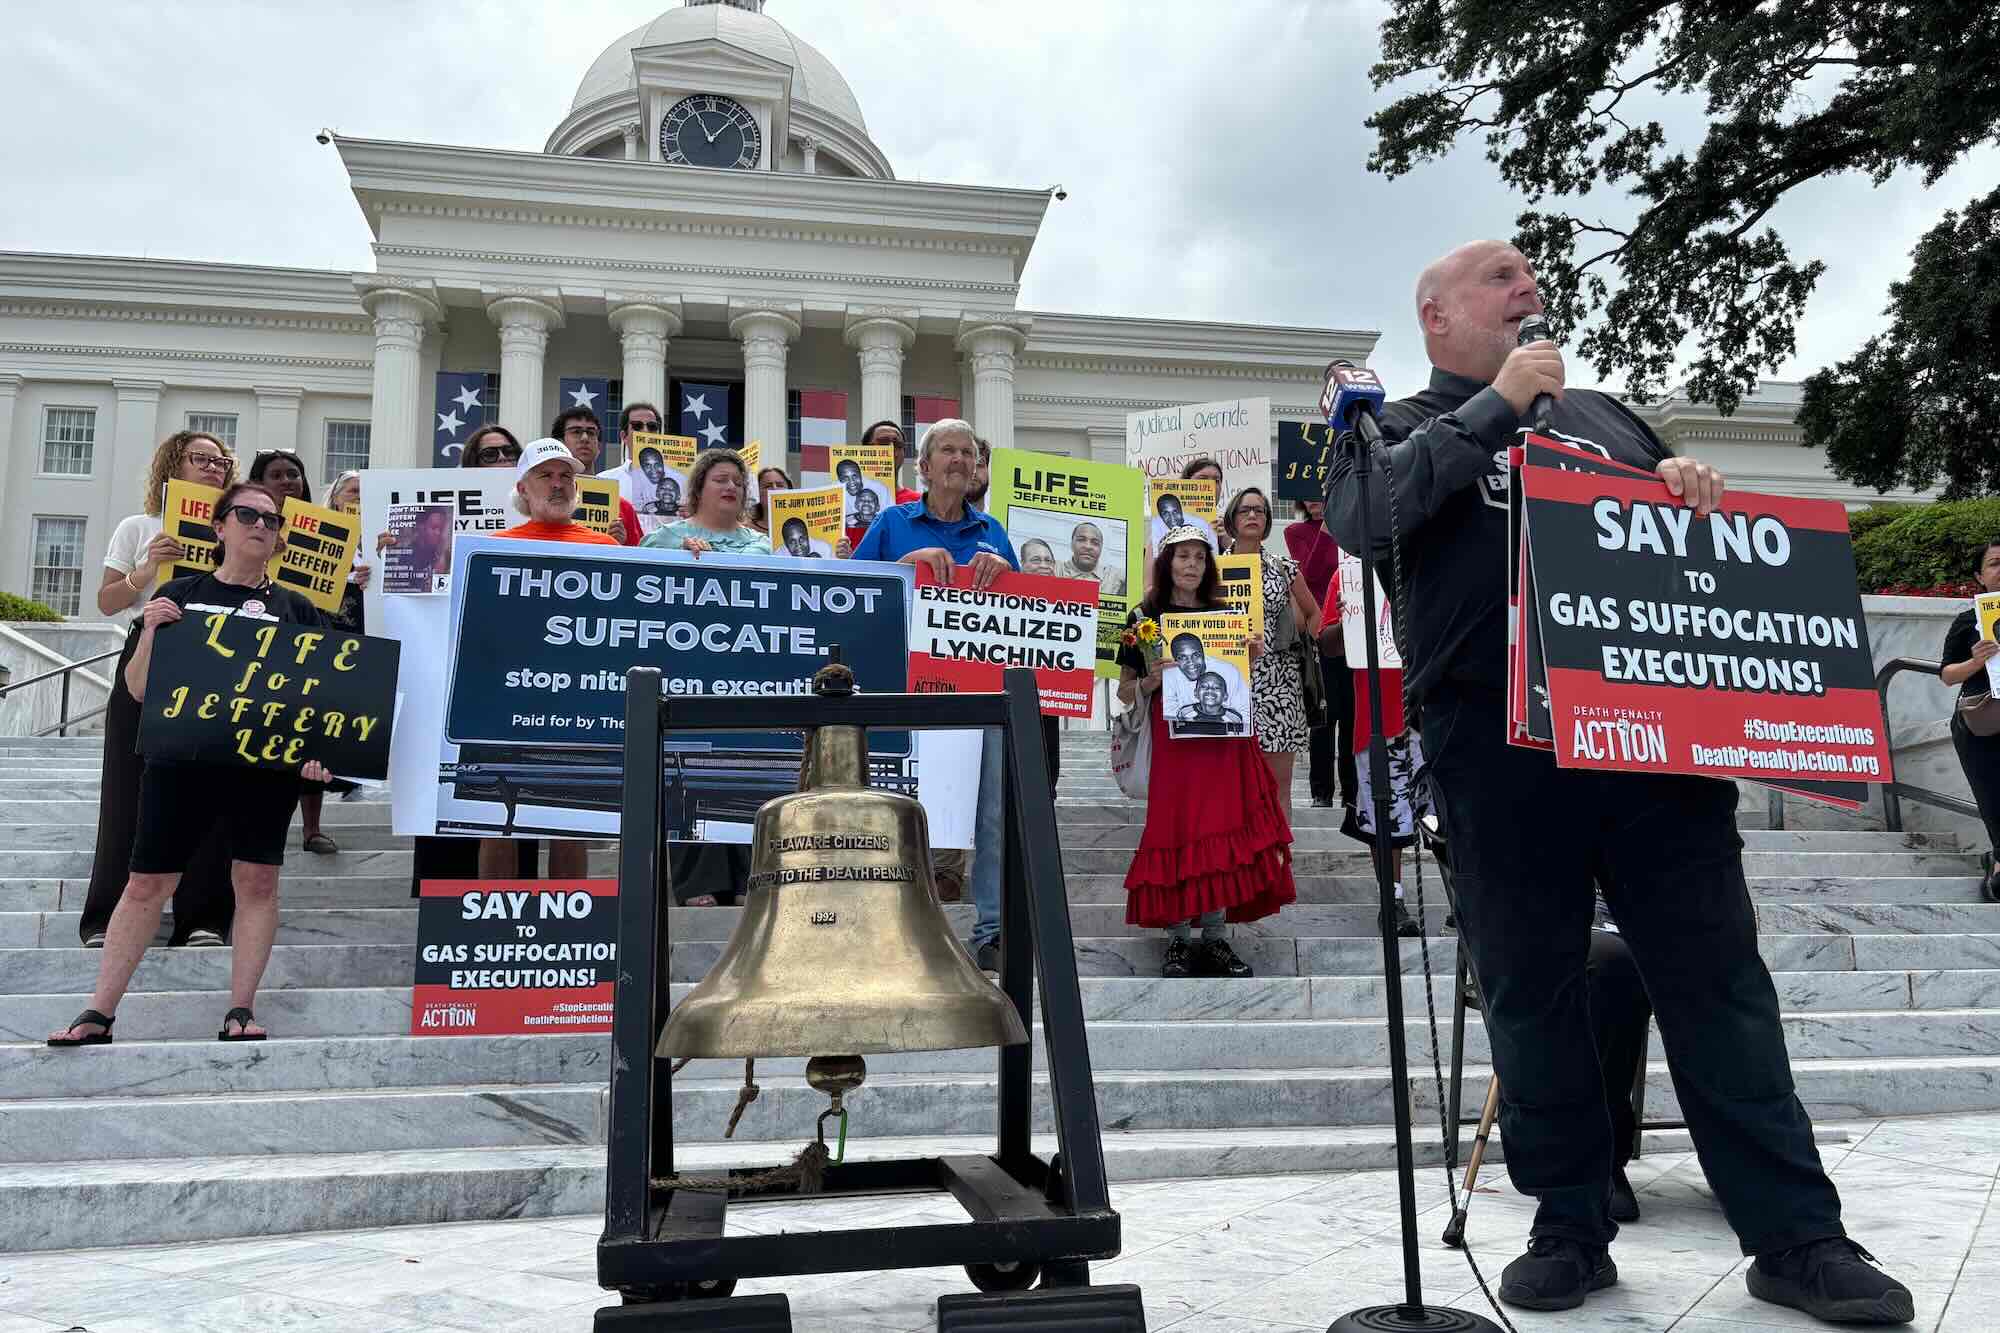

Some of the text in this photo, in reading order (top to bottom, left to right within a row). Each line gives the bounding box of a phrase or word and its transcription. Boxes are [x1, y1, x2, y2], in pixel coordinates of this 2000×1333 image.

[1340, 370, 1377, 384] 12
[1013, 467, 1089, 498] LIFE
[180, 497, 211, 521] LIFE
[1013, 491, 1107, 512] JEFFERY LEE
[292, 513, 319, 534] LIFE
[475, 519, 506, 530] LEE
[588, 508, 609, 523] FOR
[1592, 500, 1791, 567] SAY NO
[320, 540, 344, 559] FOR
[281, 549, 338, 577] JEFFERY
[312, 576, 336, 595] LEE
[491, 566, 882, 614] THOU SHALT NOT
[1230, 583, 1252, 598] FOR
[1684, 570, 1717, 594] TO
[920, 586, 1092, 618] EXECUTIONS ARE
[1982, 602, 1995, 612] THE
[927, 608, 1082, 643] LEGALIZED
[1167, 619, 1181, 629] THE
[1182, 619, 1201, 629] JURY
[1202, 619, 1226, 629] VOTED
[1549, 593, 1859, 649] GAS SUFFOCATION
[204, 613, 360, 671] LIFE
[543, 615, 829, 656] SUFFOCATE.
[931, 638, 1076, 671] LYNCHING
[235, 661, 320, 696] for
[505, 668, 571, 693] stop
[1601, 646, 1825, 694] EXECUTIONS!
[163, 686, 378, 742] JEFFERY
[512, 714, 545, 727] Paid
[550, 714, 572, 728] for
[576, 715, 596, 730] by
[1574, 706, 1663, 722] DEATH PENALTY
[1572, 718, 1669, 764] ACTION
[1744, 719, 1875, 746] #StopExecutions
[235, 729, 305, 764] LEE
[1691, 744, 1880, 776] DeathPenaltyAction.org
[769, 834, 890, 851] DELAWARE CITIZENS
[780, 869, 795, 882] TO
[797, 867, 822, 882] THE
[826, 865, 871, 882] DEATH
[461, 891, 593, 921] SAY NO
[812, 911, 836, 924] 1992
[516, 925, 537, 938] TO
[422, 944, 468, 963] GAS
[450, 968, 597, 989] EXECUTIONS!
[420, 1008, 477, 1027] ACTION
